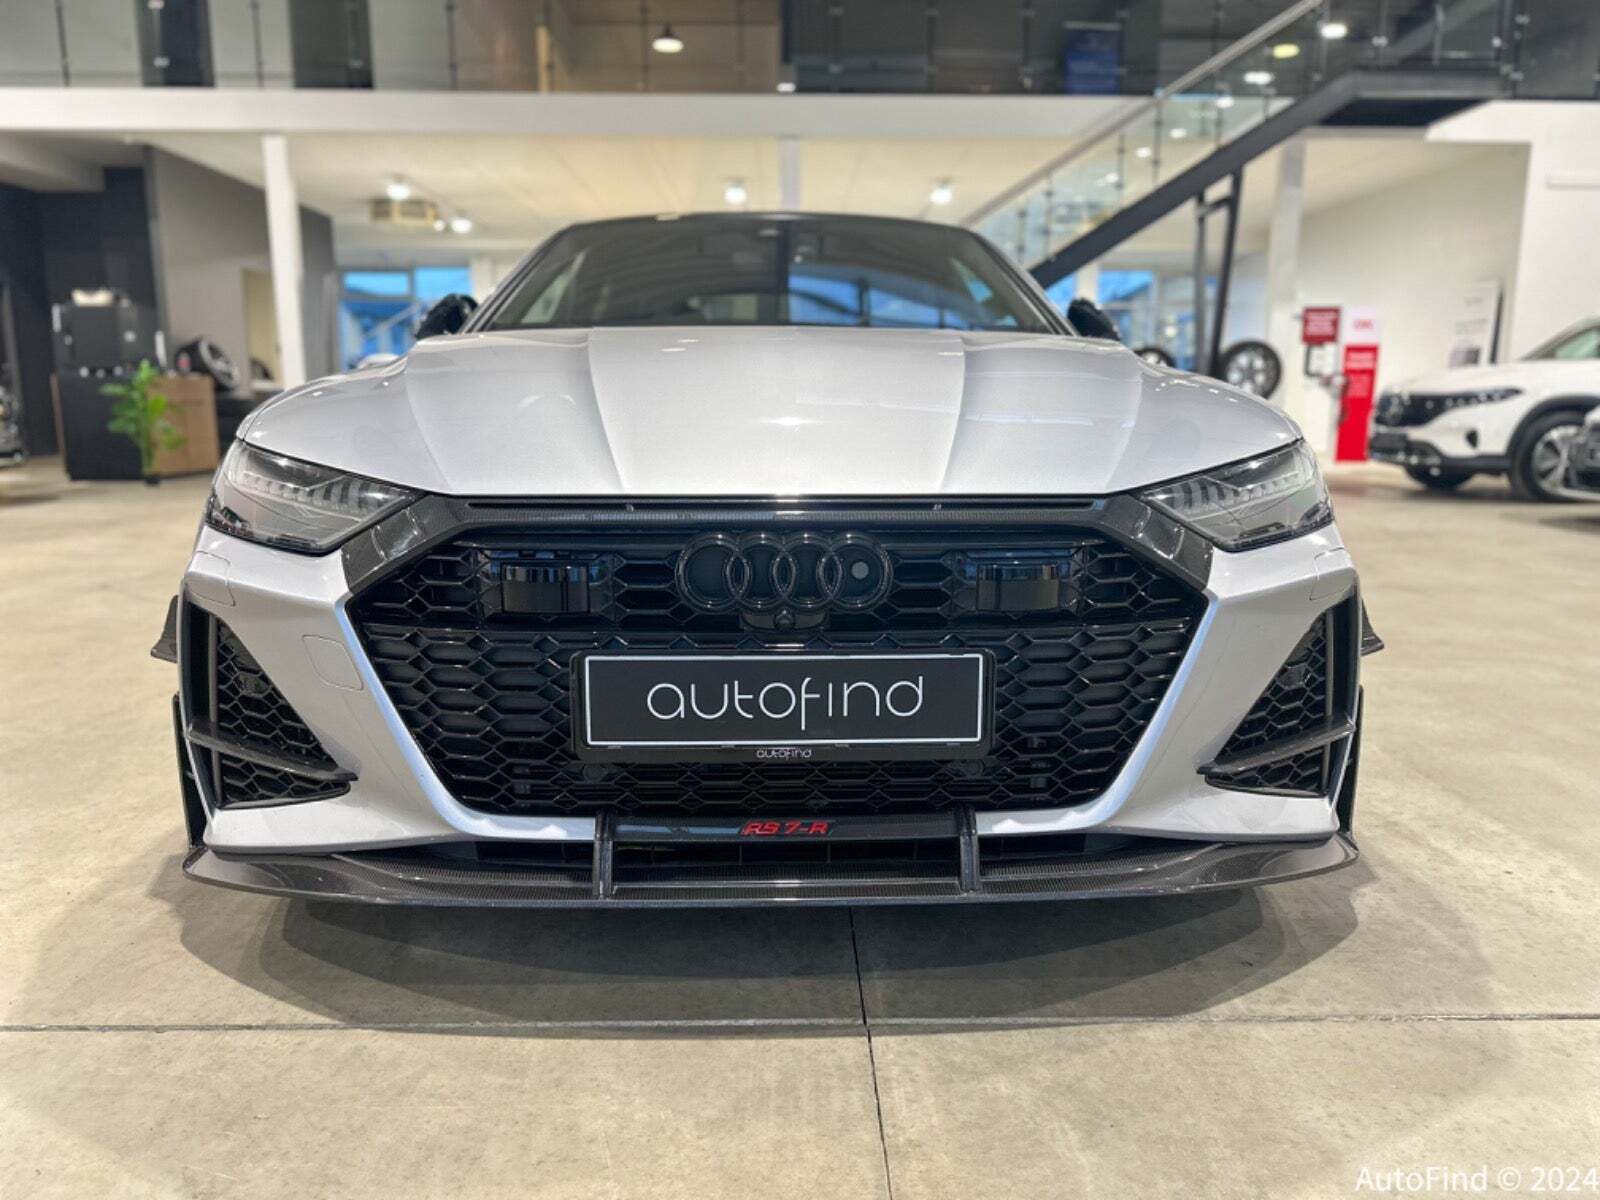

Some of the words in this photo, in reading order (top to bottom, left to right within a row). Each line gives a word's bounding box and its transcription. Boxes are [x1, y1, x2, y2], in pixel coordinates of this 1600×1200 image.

[647, 676, 923, 731] autofind
[756, 747, 812, 760] autofind
[742, 820, 780, 835] RS
[784, 820, 829, 835] 7-R
